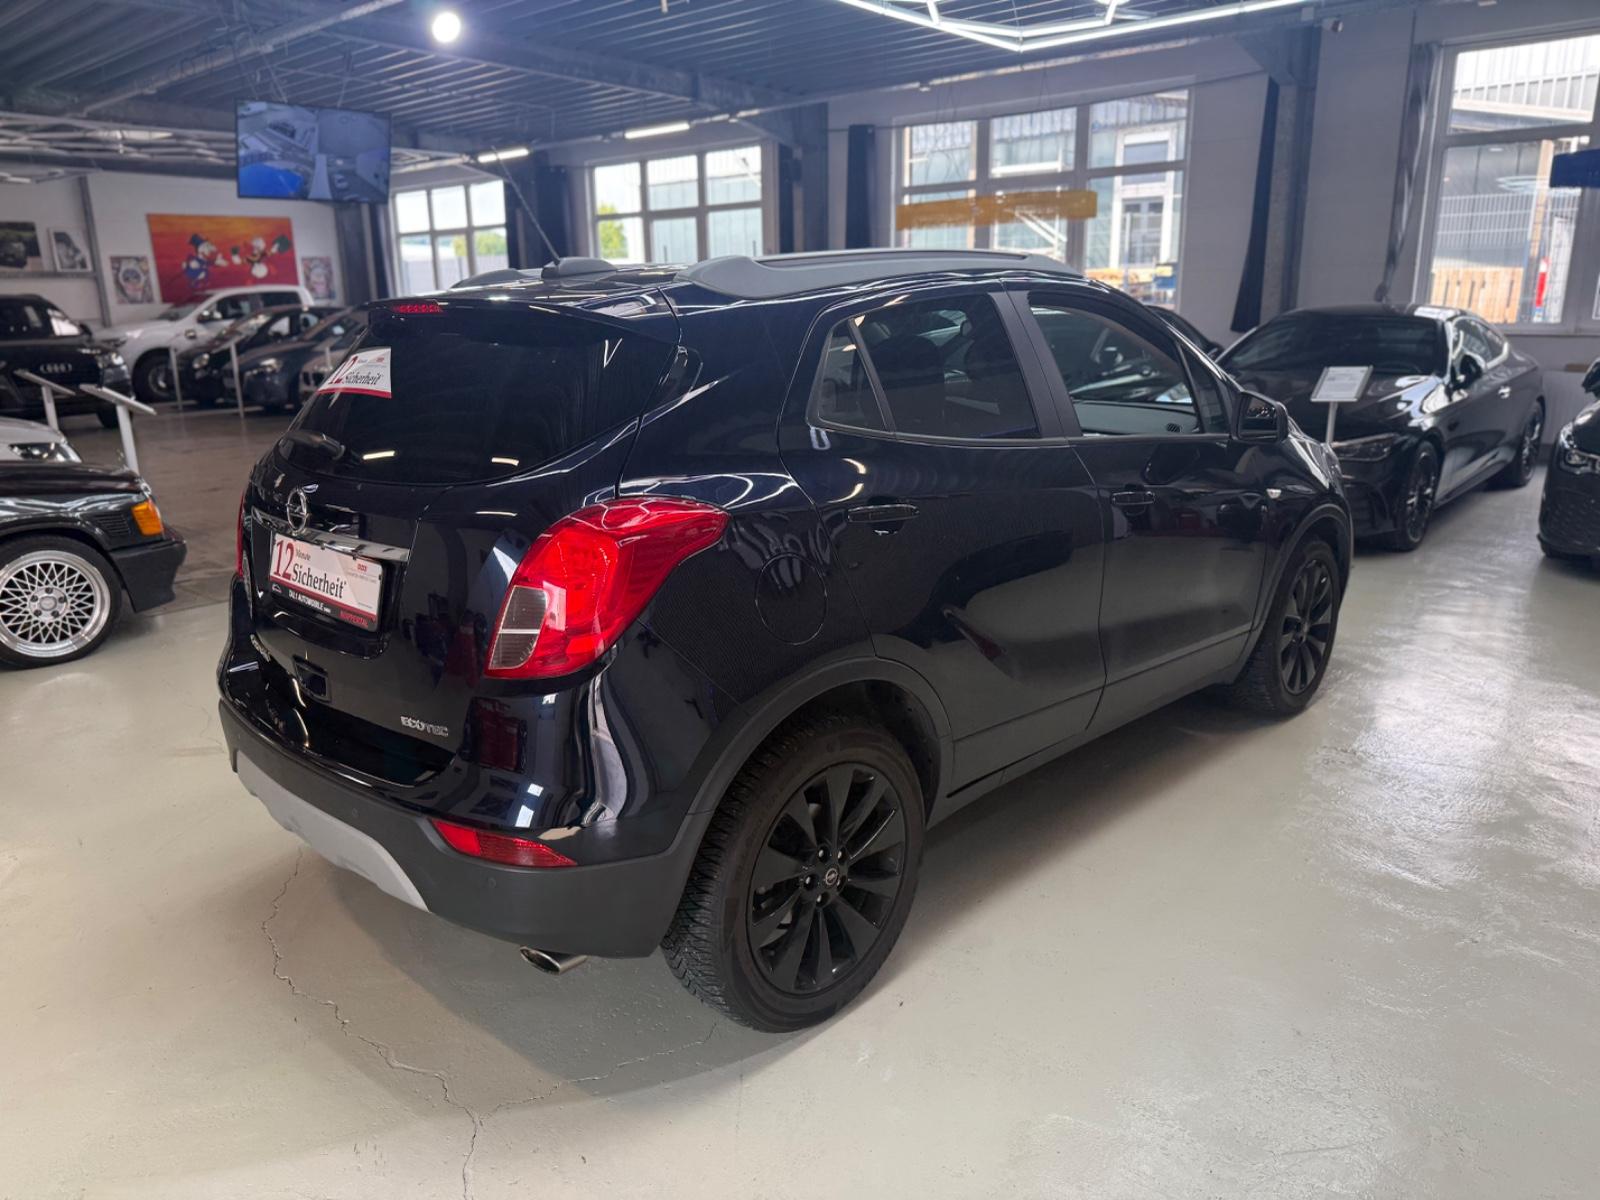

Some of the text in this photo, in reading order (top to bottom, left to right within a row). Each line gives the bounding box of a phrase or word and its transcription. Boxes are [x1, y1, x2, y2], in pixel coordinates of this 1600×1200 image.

[273, 539, 295, 581] 12
[292, 562, 346, 599] Sicherheit
[400, 715, 449, 737] ECOTEC
